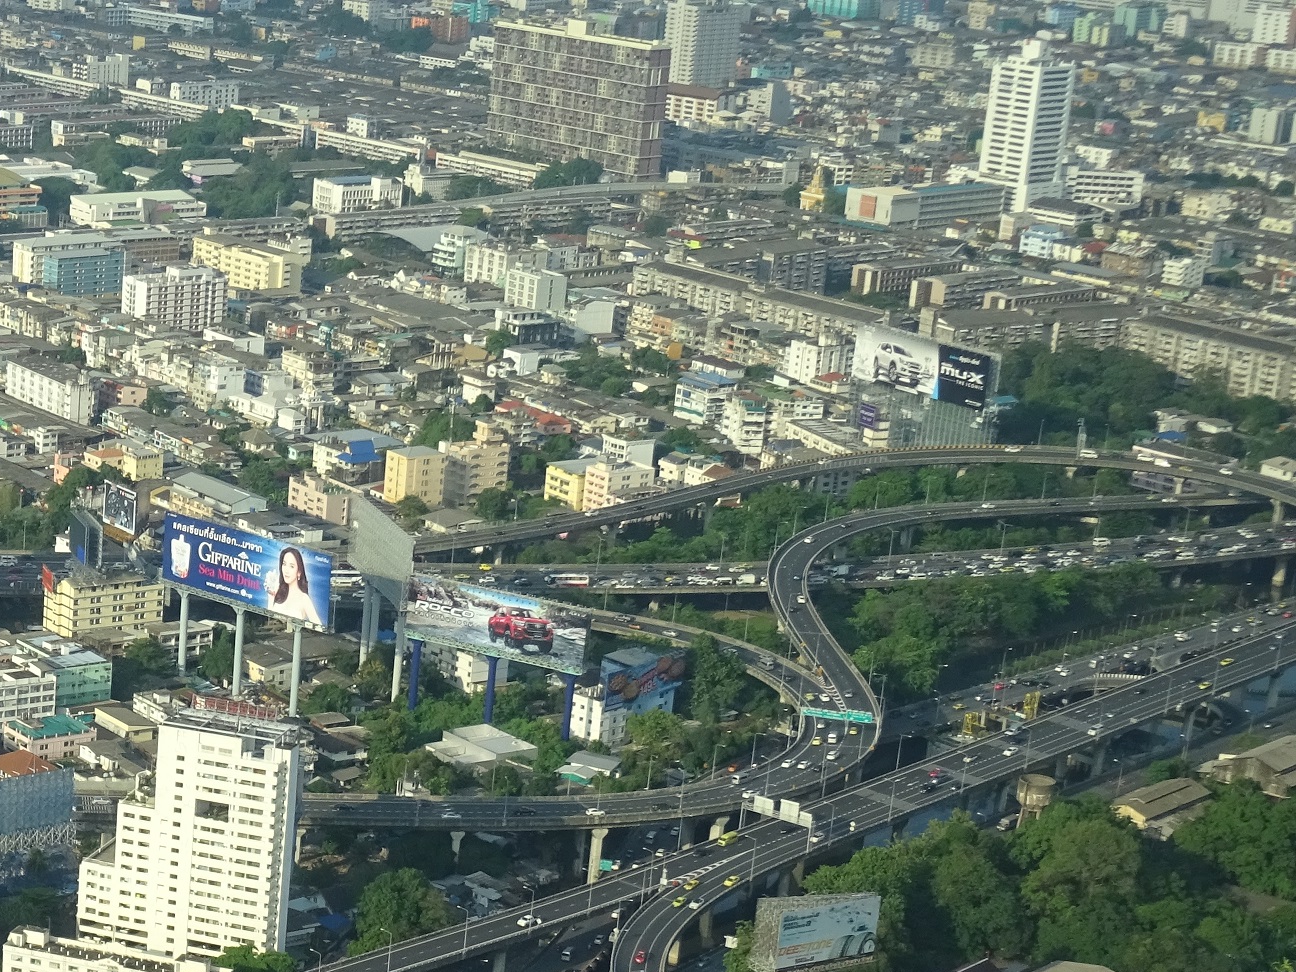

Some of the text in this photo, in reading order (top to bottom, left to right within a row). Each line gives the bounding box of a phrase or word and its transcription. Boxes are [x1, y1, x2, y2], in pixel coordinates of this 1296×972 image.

[198, 541, 261, 577] GIFFARINE
[198, 563, 261, 591] Sea Min Drink
[415, 600, 474, 619] ROCCO
